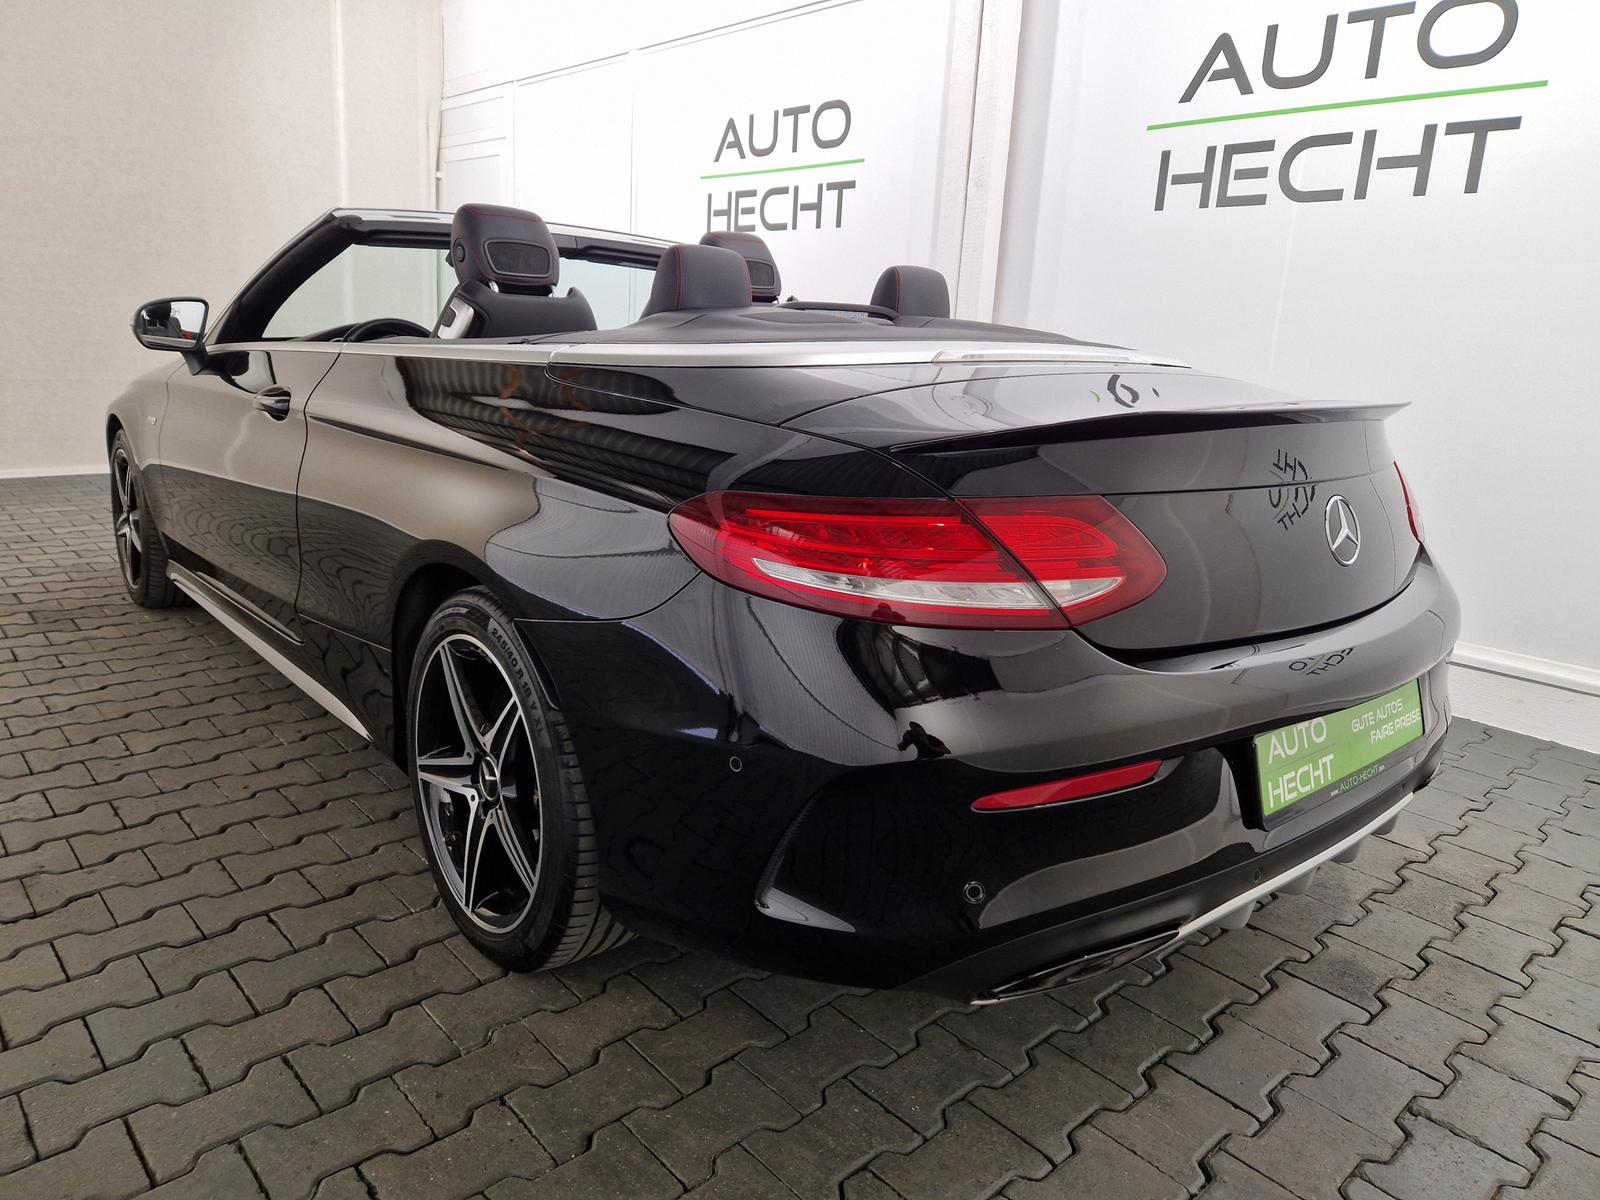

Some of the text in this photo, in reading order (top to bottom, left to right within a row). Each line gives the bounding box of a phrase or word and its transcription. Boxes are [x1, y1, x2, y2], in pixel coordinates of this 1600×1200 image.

[1178, 0, 1519, 104] AUTO
[713, 99, 852, 163] AUTO
[1154, 116, 1523, 212] HECHT
[706, 180, 856, 233] HECHT
[1267, 717, 1328, 765] AUTO
[1352, 698, 1404, 732] GUTE AUTOS
[1370, 708, 1421, 745] FAIRE PREISE
[1267, 754, 1334, 808] HECHT
